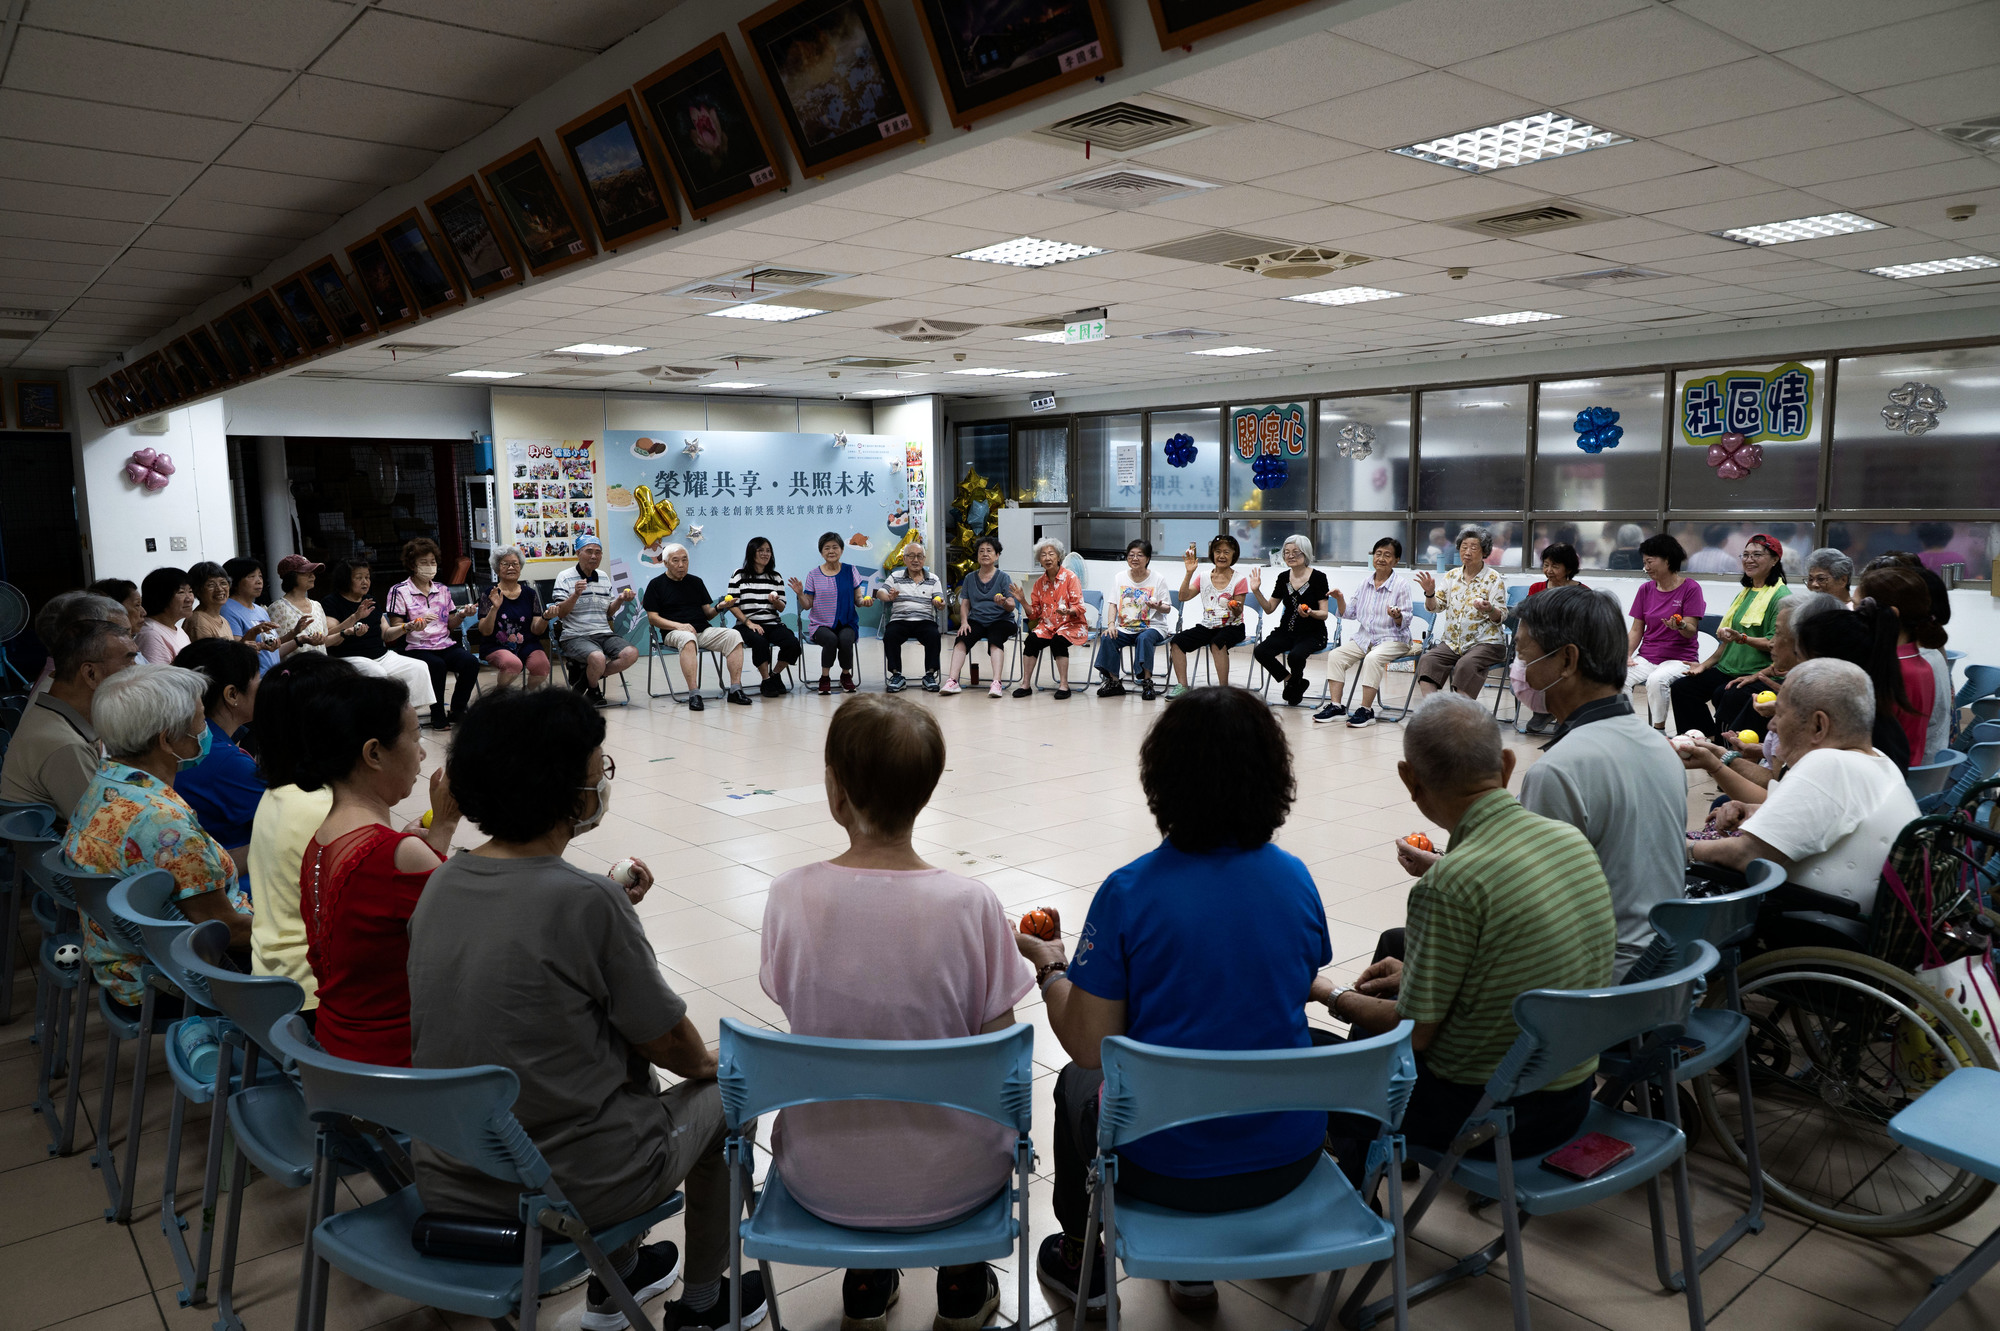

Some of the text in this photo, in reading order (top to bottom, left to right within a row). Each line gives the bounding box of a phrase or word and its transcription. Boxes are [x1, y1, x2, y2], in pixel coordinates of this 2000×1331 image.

[1685, 371, 1807, 436] 社區情
[1236, 409, 1304, 458] 關懷心
